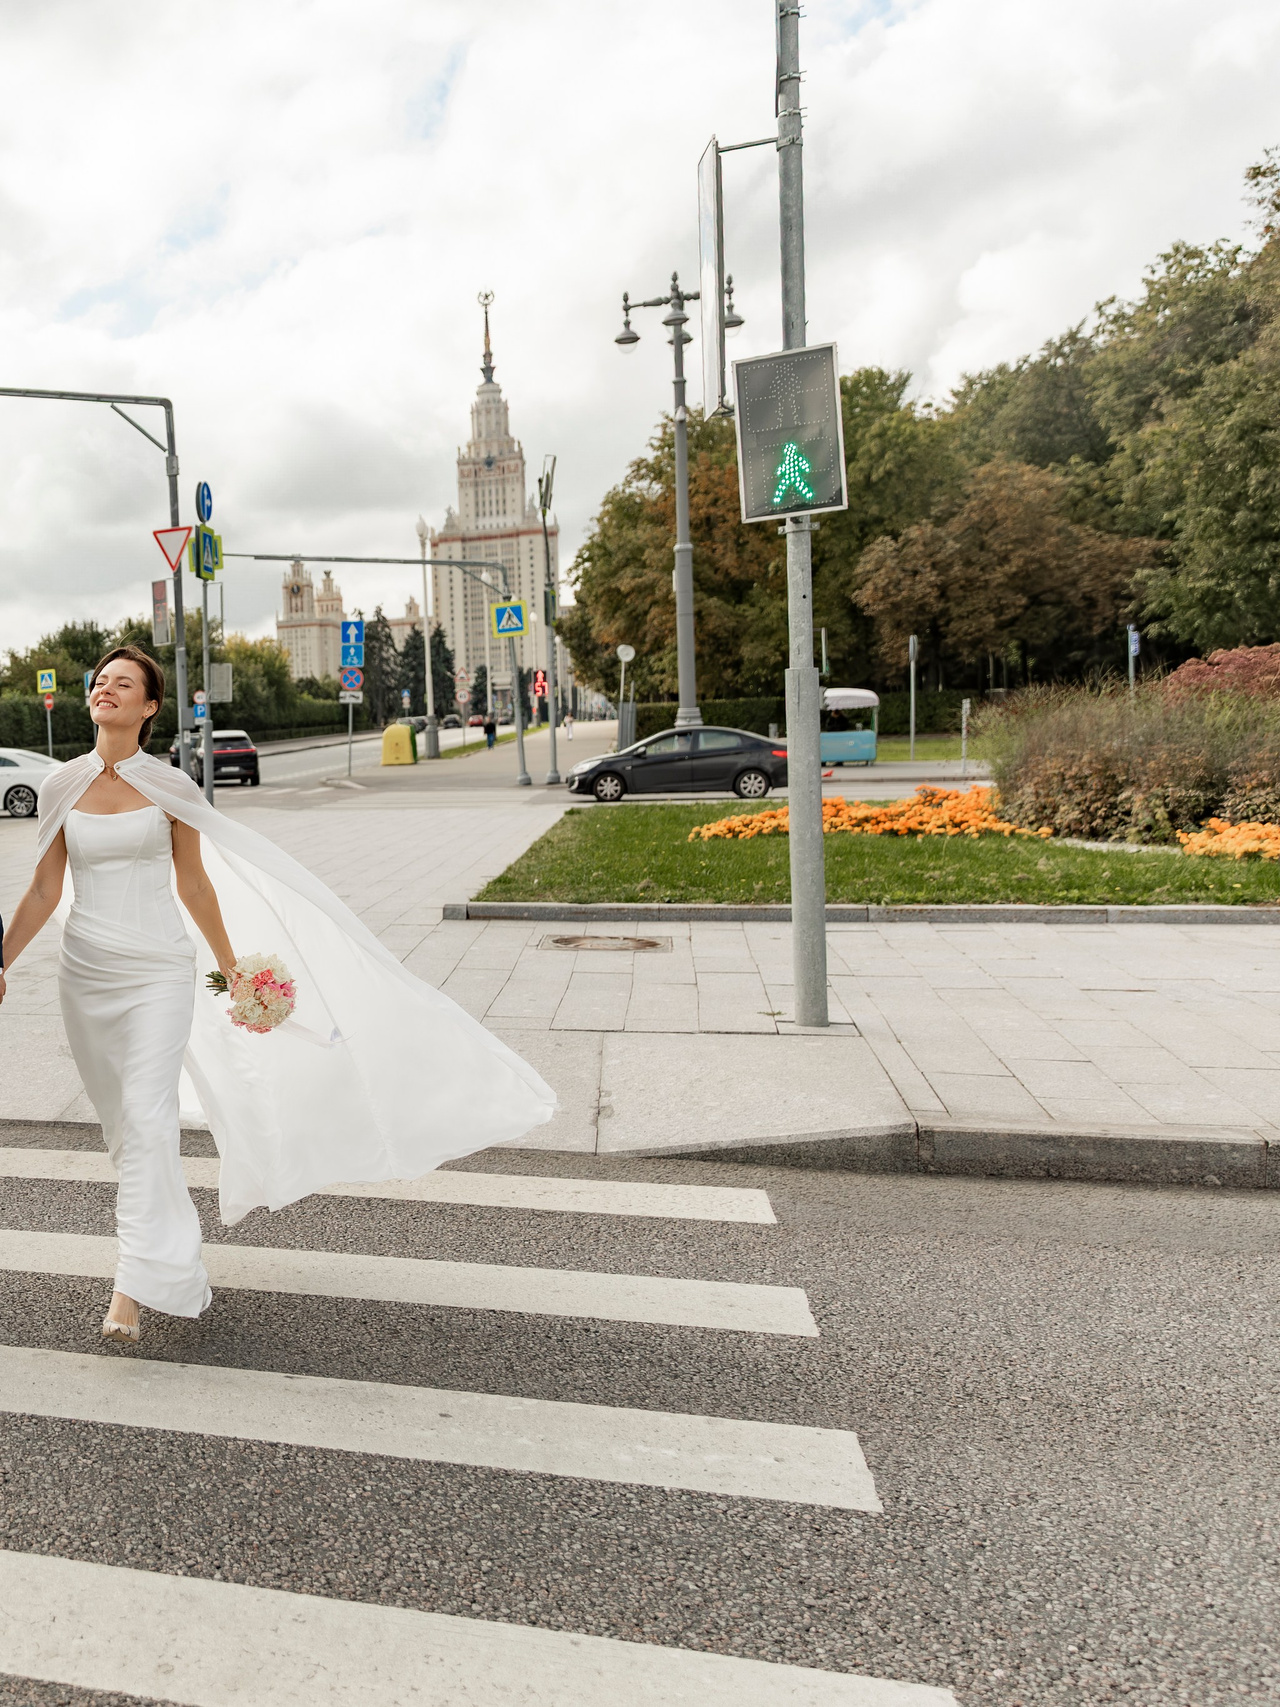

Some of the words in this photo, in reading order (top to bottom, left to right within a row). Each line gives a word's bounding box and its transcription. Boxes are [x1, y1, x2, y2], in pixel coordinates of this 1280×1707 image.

[155, 602, 168, 622] 57
[534, 681, 549, 697] 57
[197, 705, 205, 716] P
